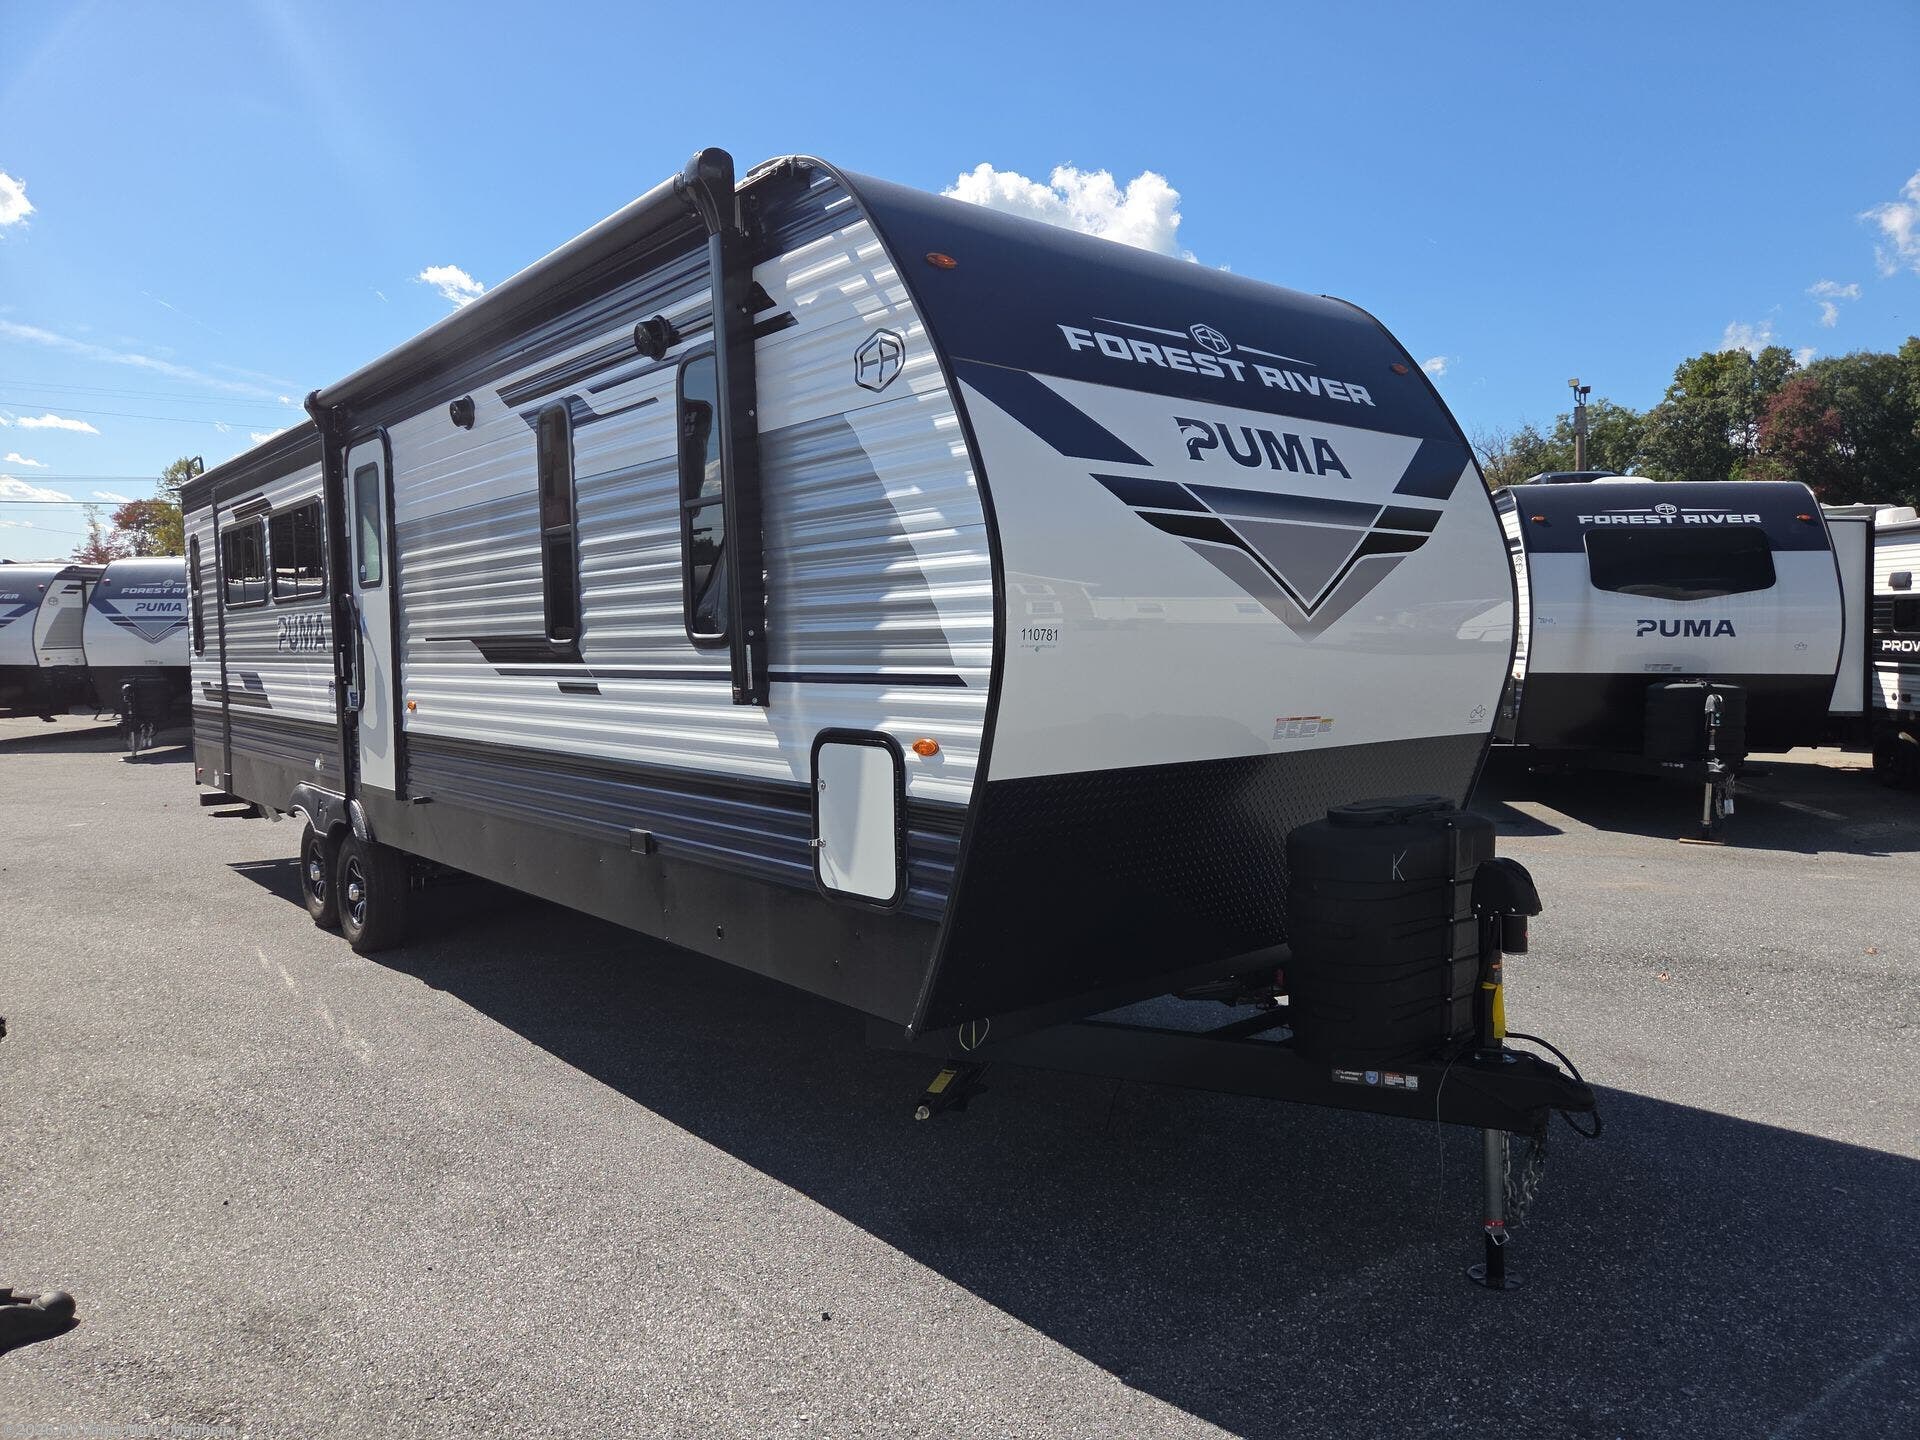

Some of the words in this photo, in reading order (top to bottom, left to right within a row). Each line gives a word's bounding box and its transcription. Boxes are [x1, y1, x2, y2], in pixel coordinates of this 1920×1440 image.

[1057, 324, 1245, 382] FOREST
[1252, 364, 1377, 407] RIVER
[1173, 416, 1353, 480] PUMA
[1577, 515, 1677, 524] FOREST
[1681, 514, 1761, 524] RIVER
[135, 602, 182, 612] PUMA
[276, 613, 327, 653] PUMA
[1021, 628, 1058, 641] 110781
[1636, 619, 1737, 638] PUMA
[1392, 850, 1408, 881] K
